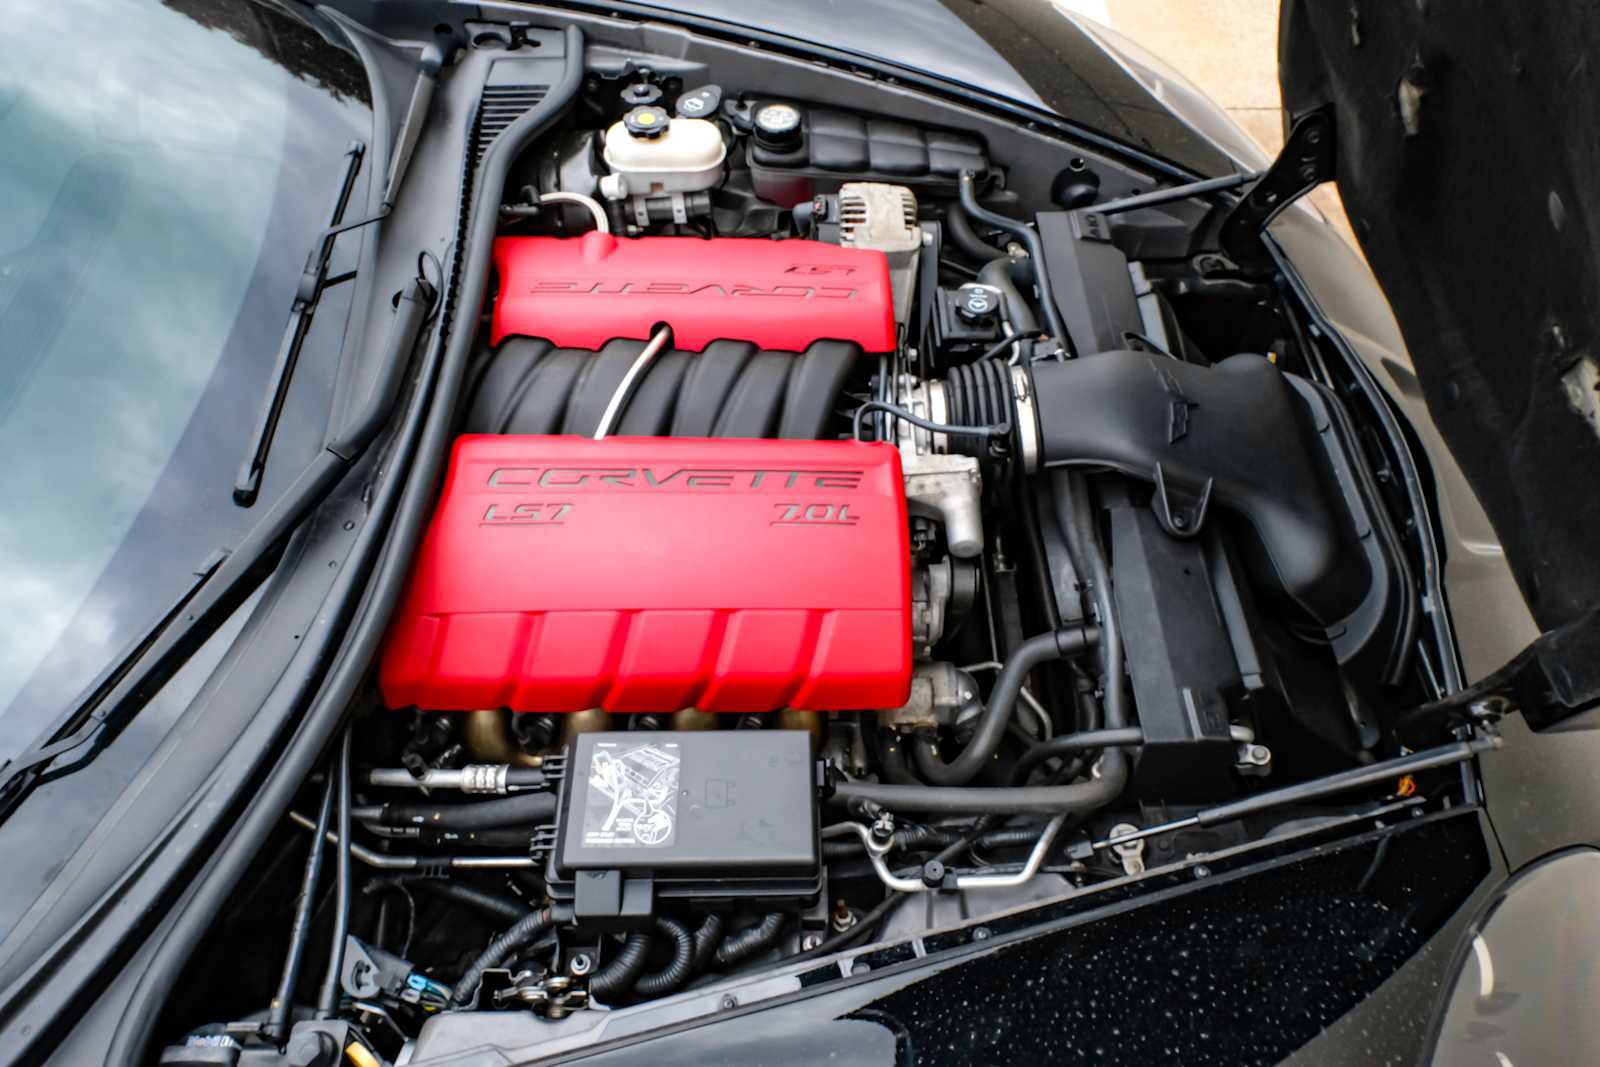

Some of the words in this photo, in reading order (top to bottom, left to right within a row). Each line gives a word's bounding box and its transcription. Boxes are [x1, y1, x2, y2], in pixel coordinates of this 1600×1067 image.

[530, 282, 858, 299] CORVETTE
[486, 467, 864, 488] CORVETTE
[481, 503, 574, 521] LS7
[773, 503, 860, 521] 7.0L
